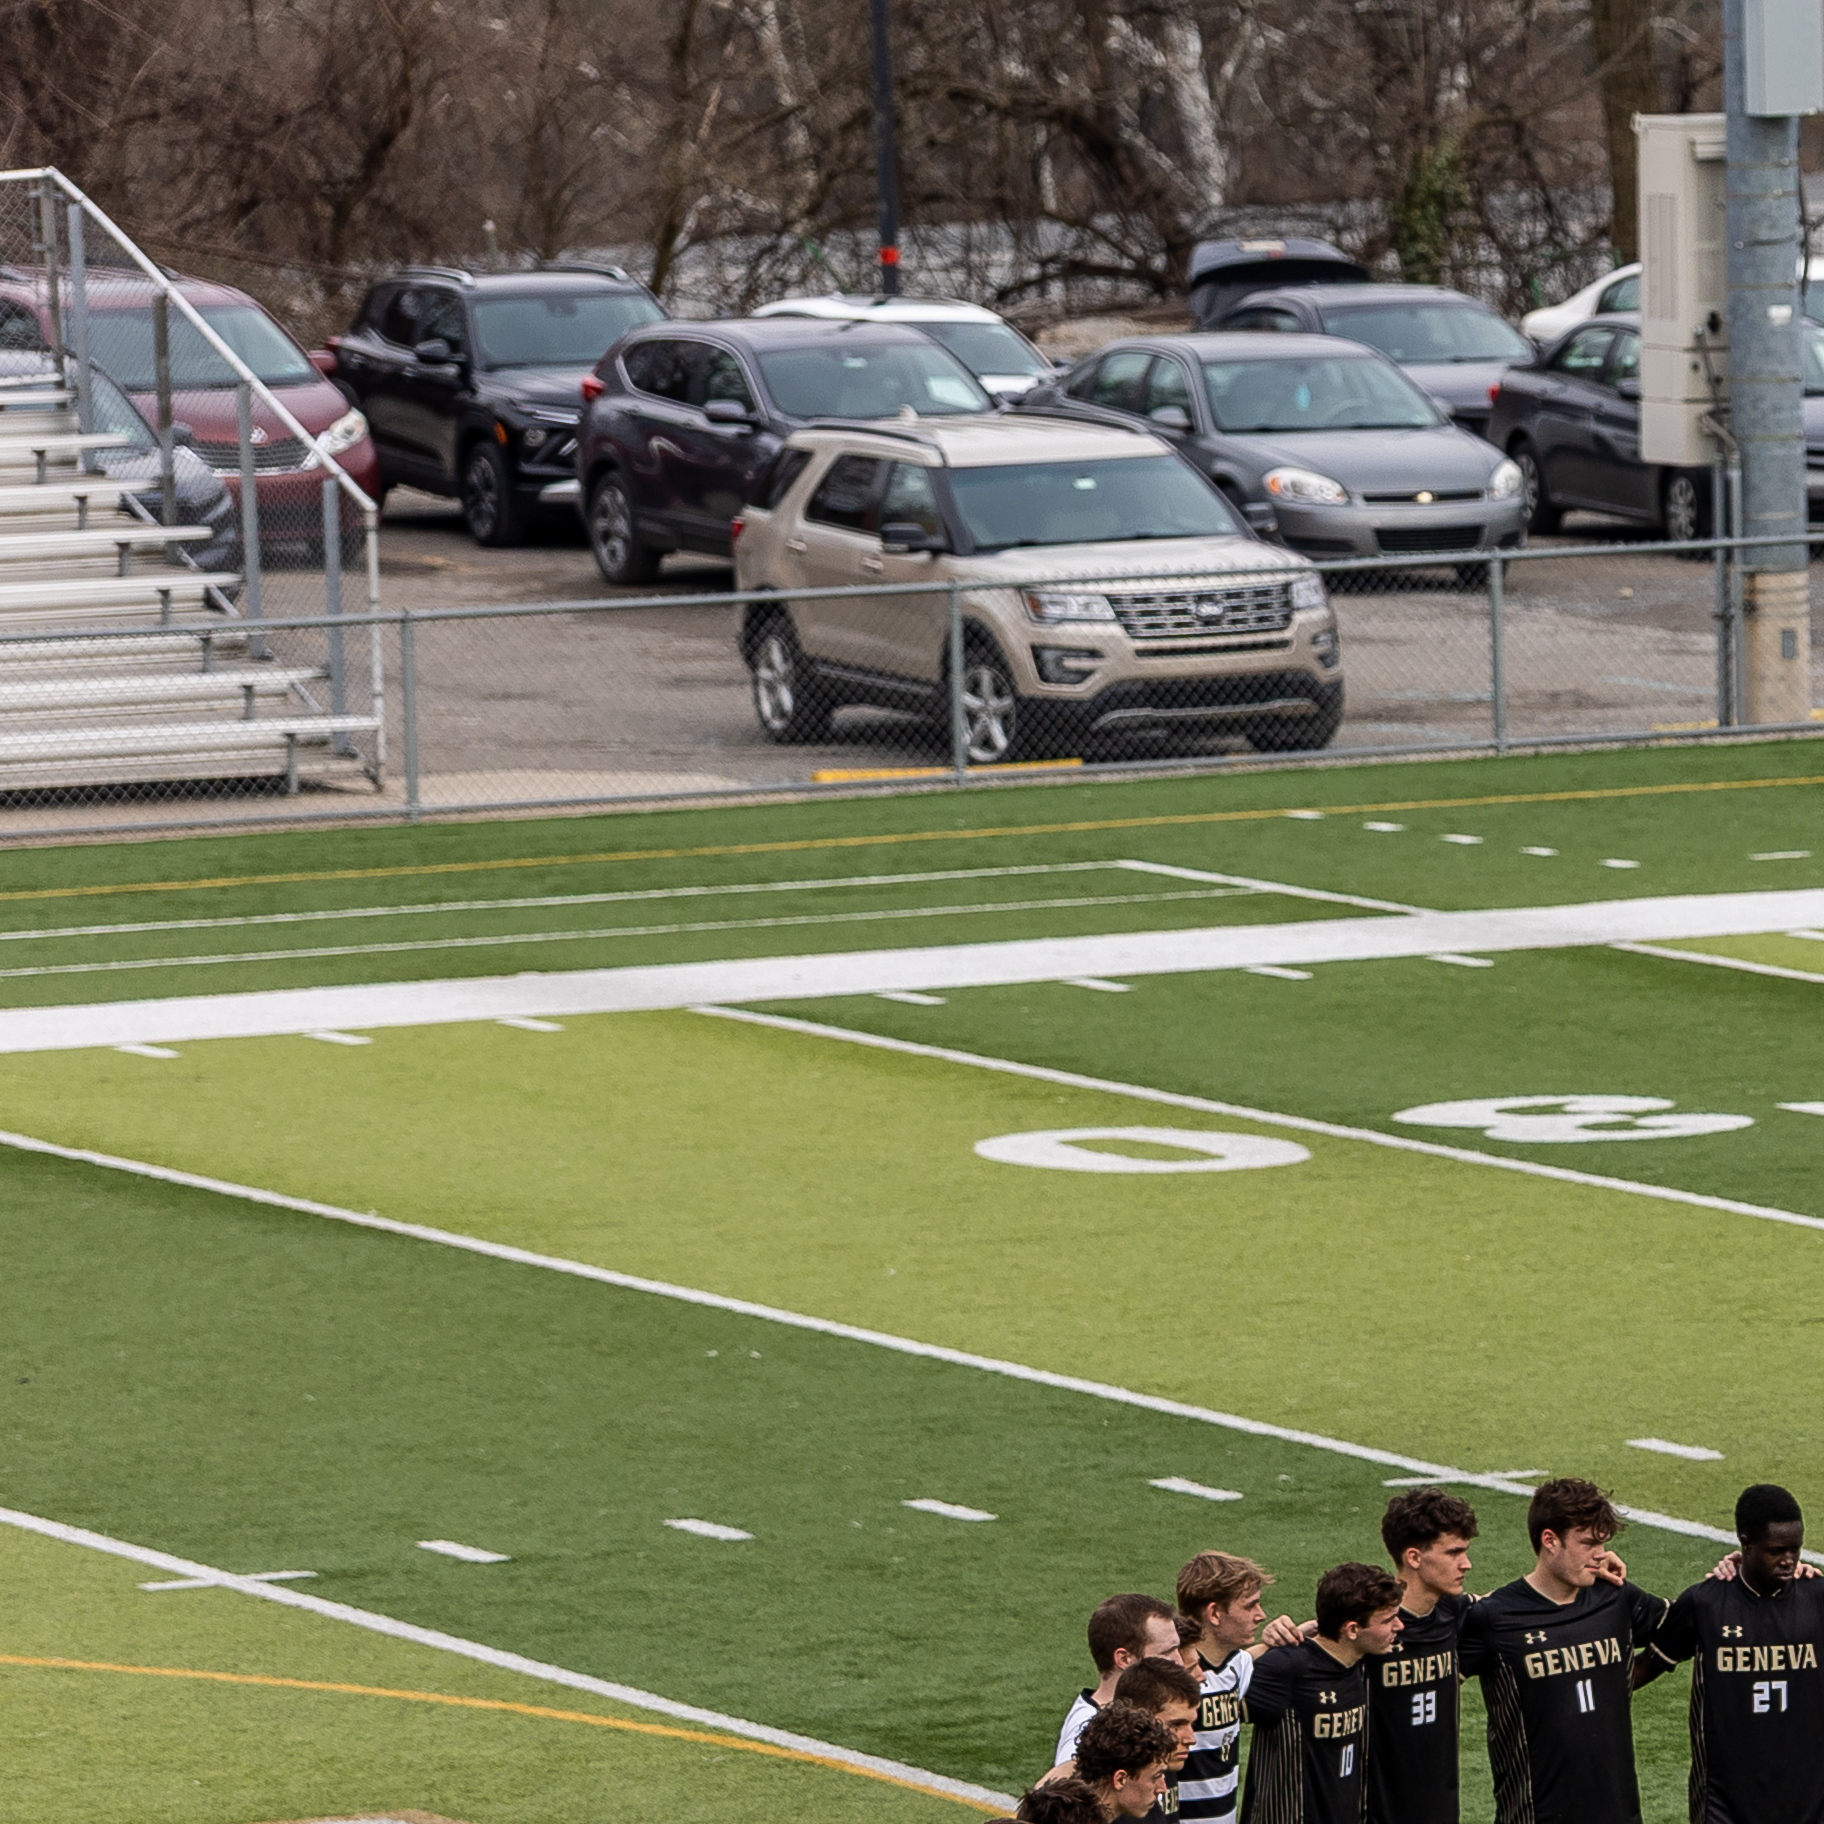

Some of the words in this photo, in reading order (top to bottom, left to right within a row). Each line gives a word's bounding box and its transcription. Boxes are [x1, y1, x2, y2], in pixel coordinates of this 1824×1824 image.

[1524, 1636, 1622, 1680] GENEVA
[1716, 1643, 1818, 1673] GENEVA
[1202, 1689, 1239, 1728] GENEV
[1411, 1689, 1437, 1726] 33
[1575, 1678, 1596, 1714] 11
[1752, 1680, 1789, 1714] 27
[1313, 1704, 1367, 1739] GENEV
[1339, 1743, 1355, 1778] 10
